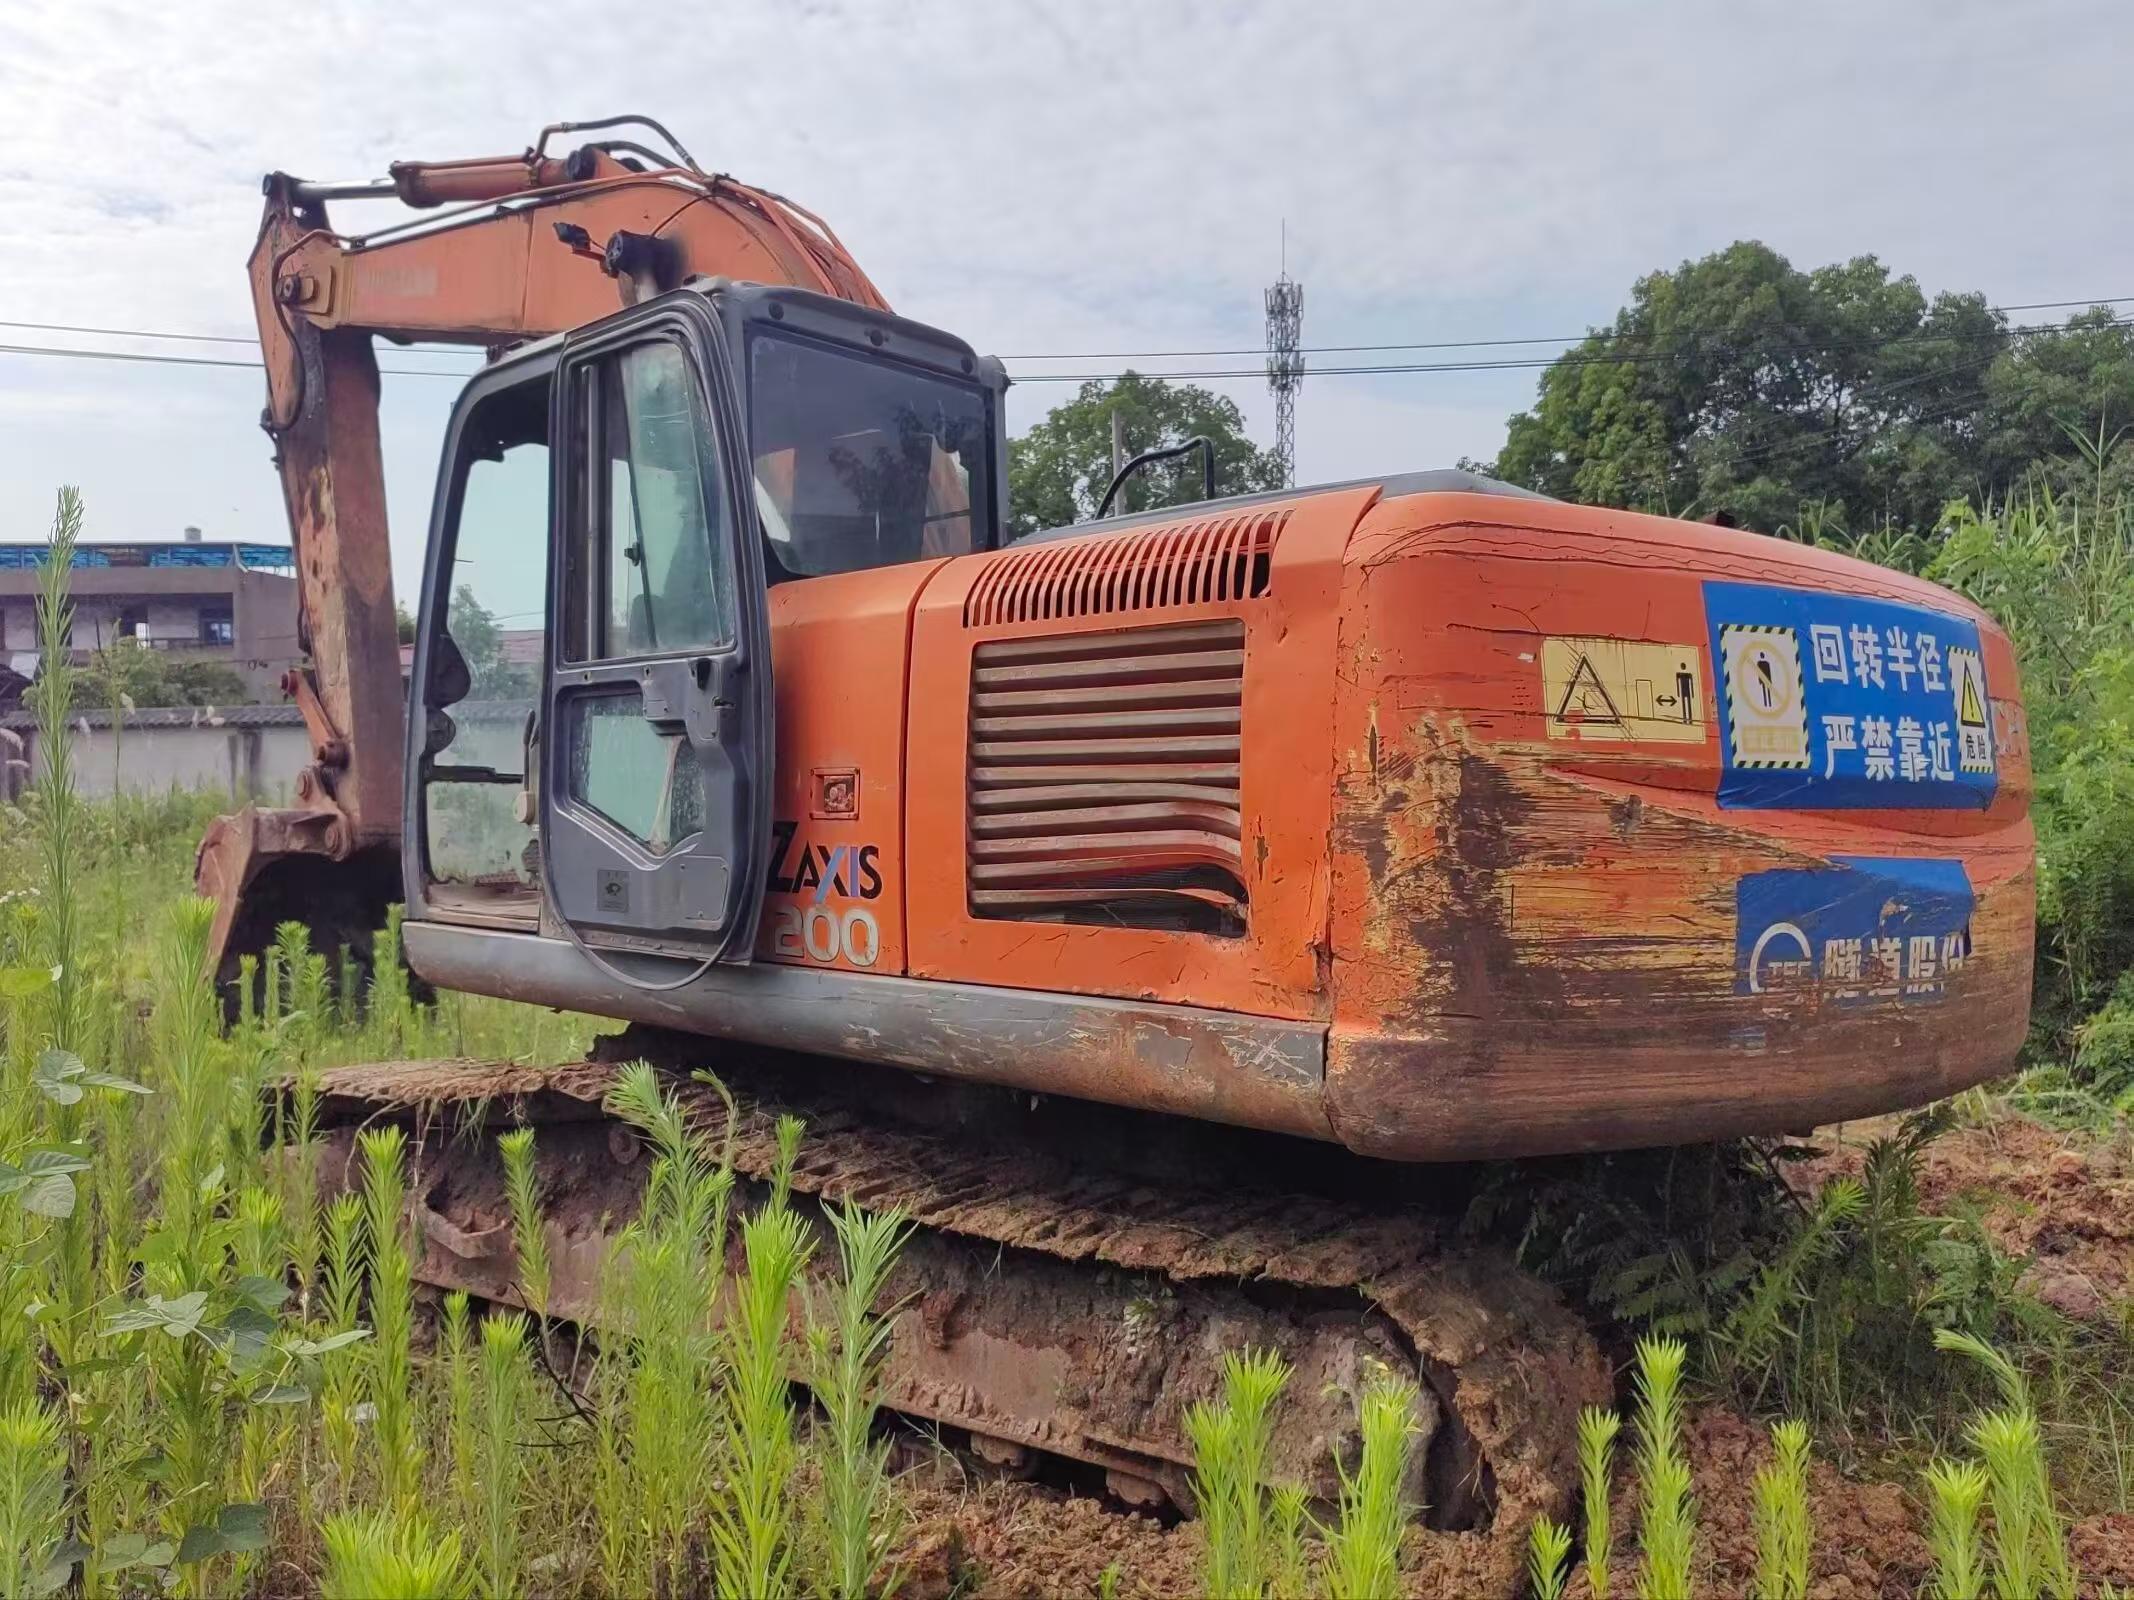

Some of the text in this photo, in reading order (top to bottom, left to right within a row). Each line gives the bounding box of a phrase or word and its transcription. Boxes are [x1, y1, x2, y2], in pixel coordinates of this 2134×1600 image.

[1810, 623, 1946, 693] 回转半径
[1821, 715, 1955, 782] 严禁靠近
[766, 821, 882, 904] ZAXIS
[774, 904, 879, 967] 200
